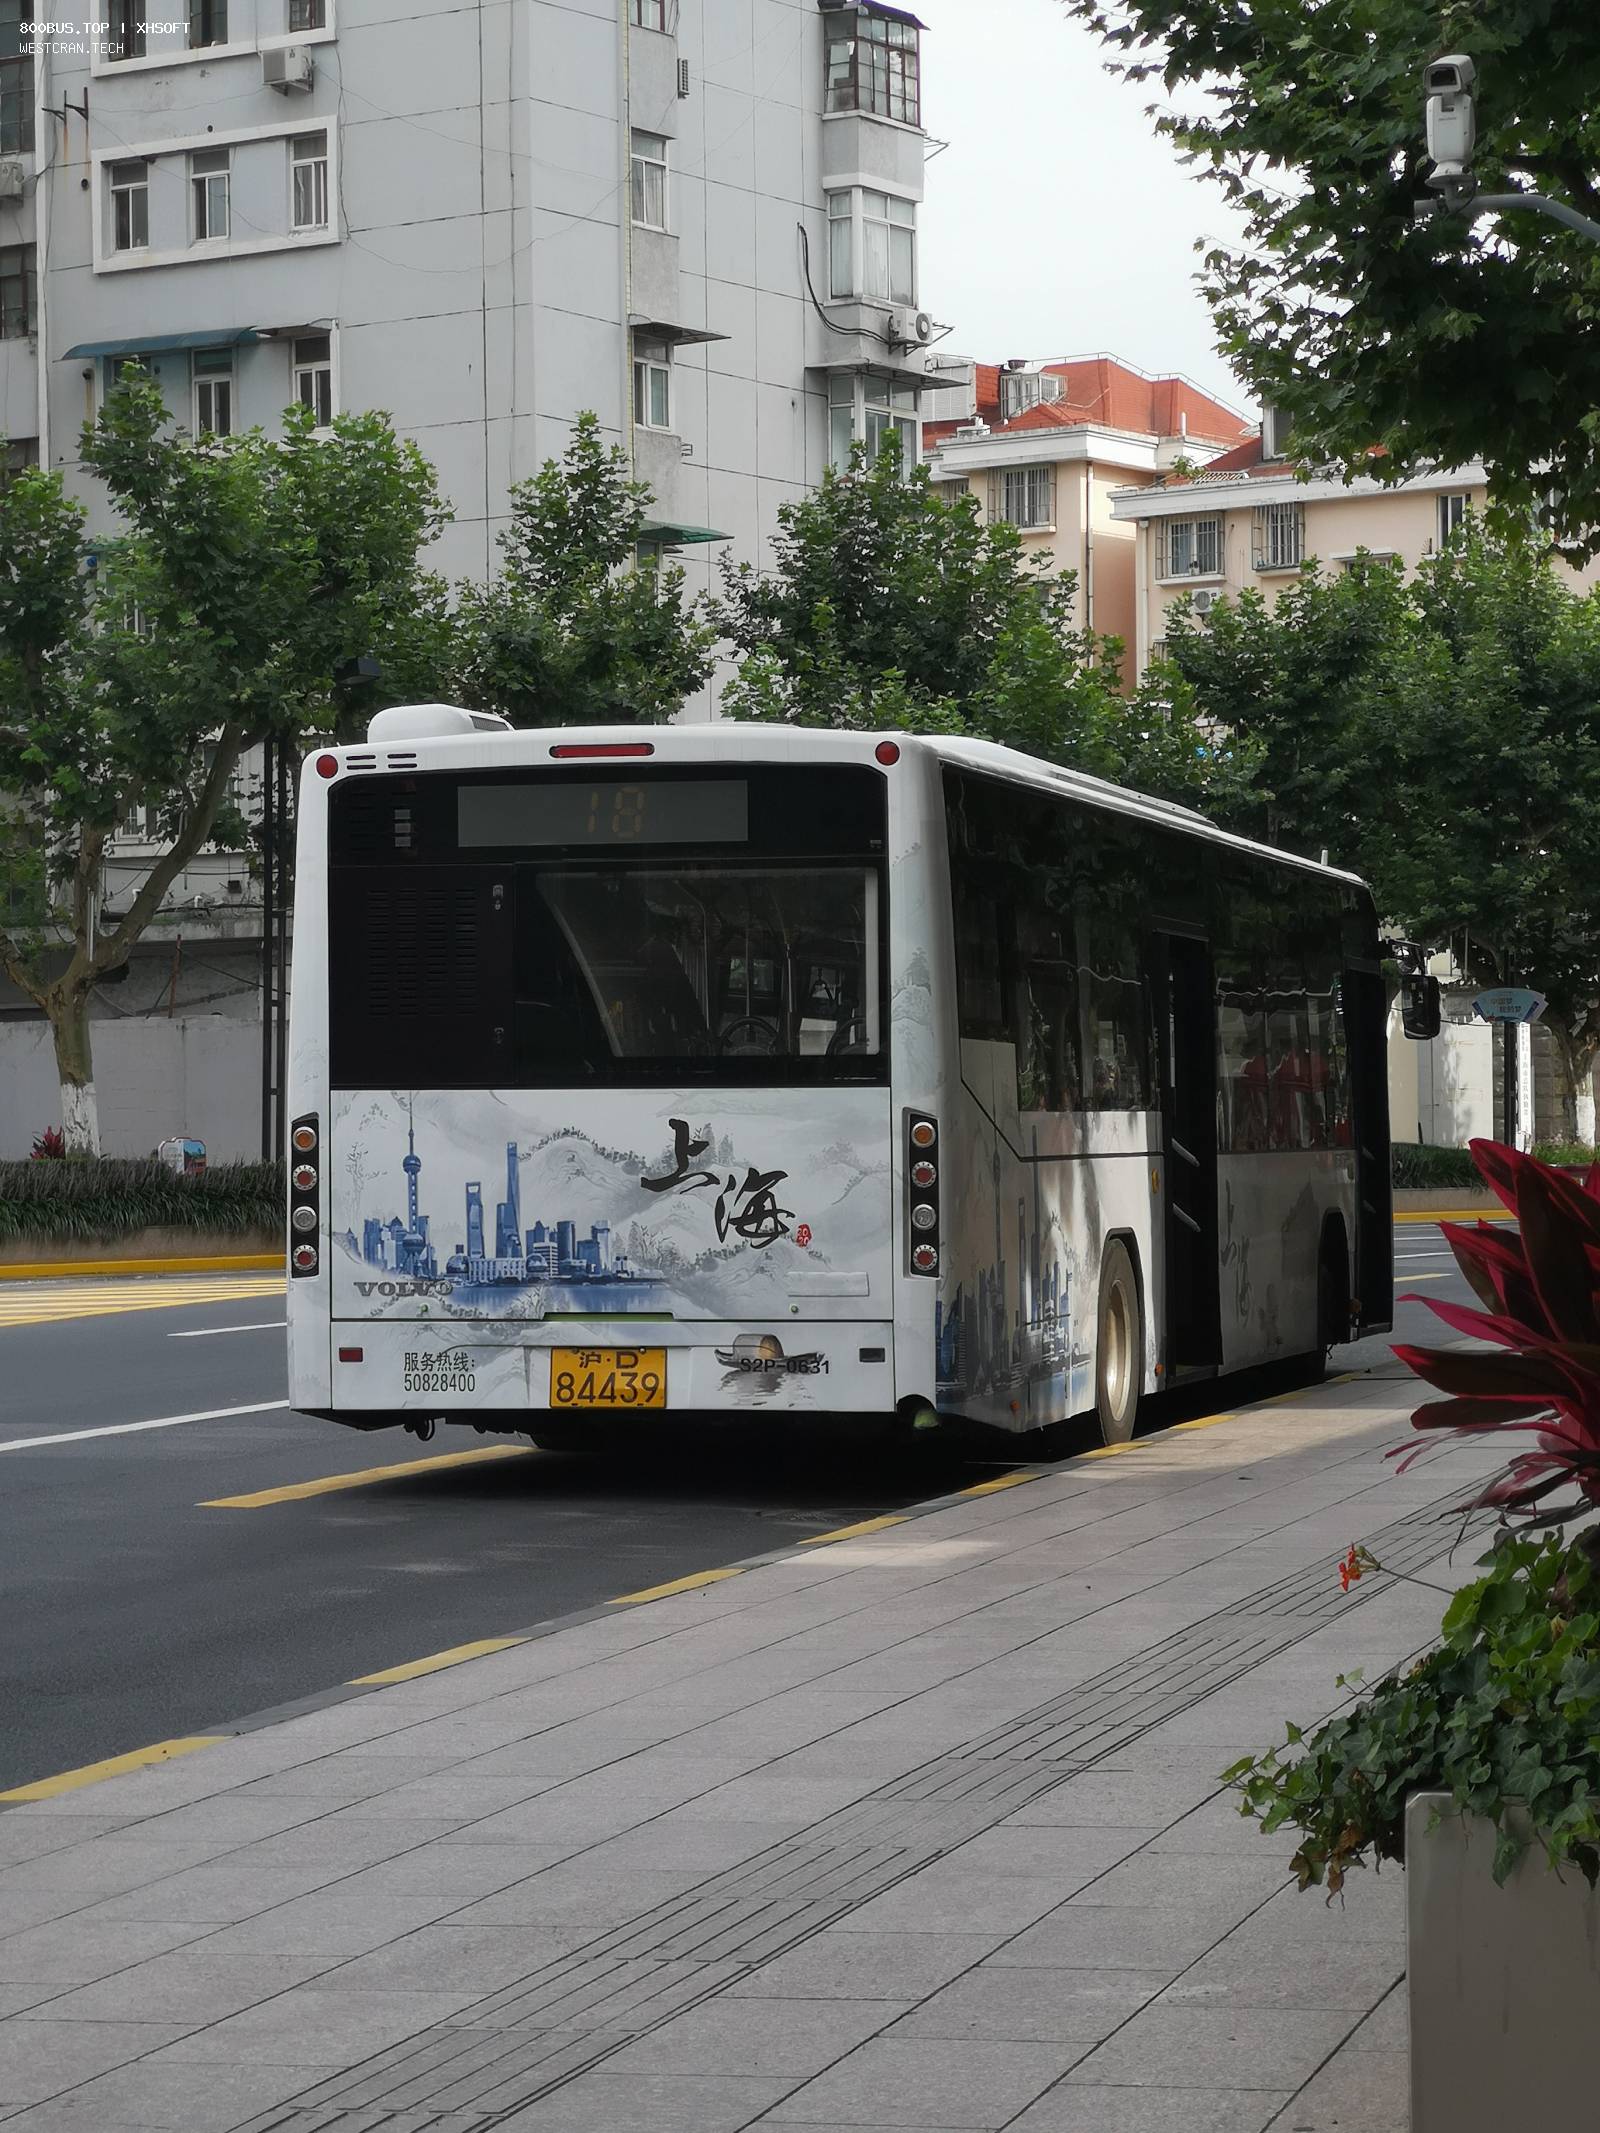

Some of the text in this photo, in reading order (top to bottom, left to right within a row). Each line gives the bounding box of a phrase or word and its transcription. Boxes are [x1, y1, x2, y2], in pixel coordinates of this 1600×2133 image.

[587, 786, 645, 838] 18
[640, 1118, 796, 1249] 上海
[353, 1281, 454, 1297] VOLVO
[740, 1358, 830, 1374] S2P-0631
[404, 1373, 476, 1392] 50828400
[556, 1372, 660, 1403] 84439
